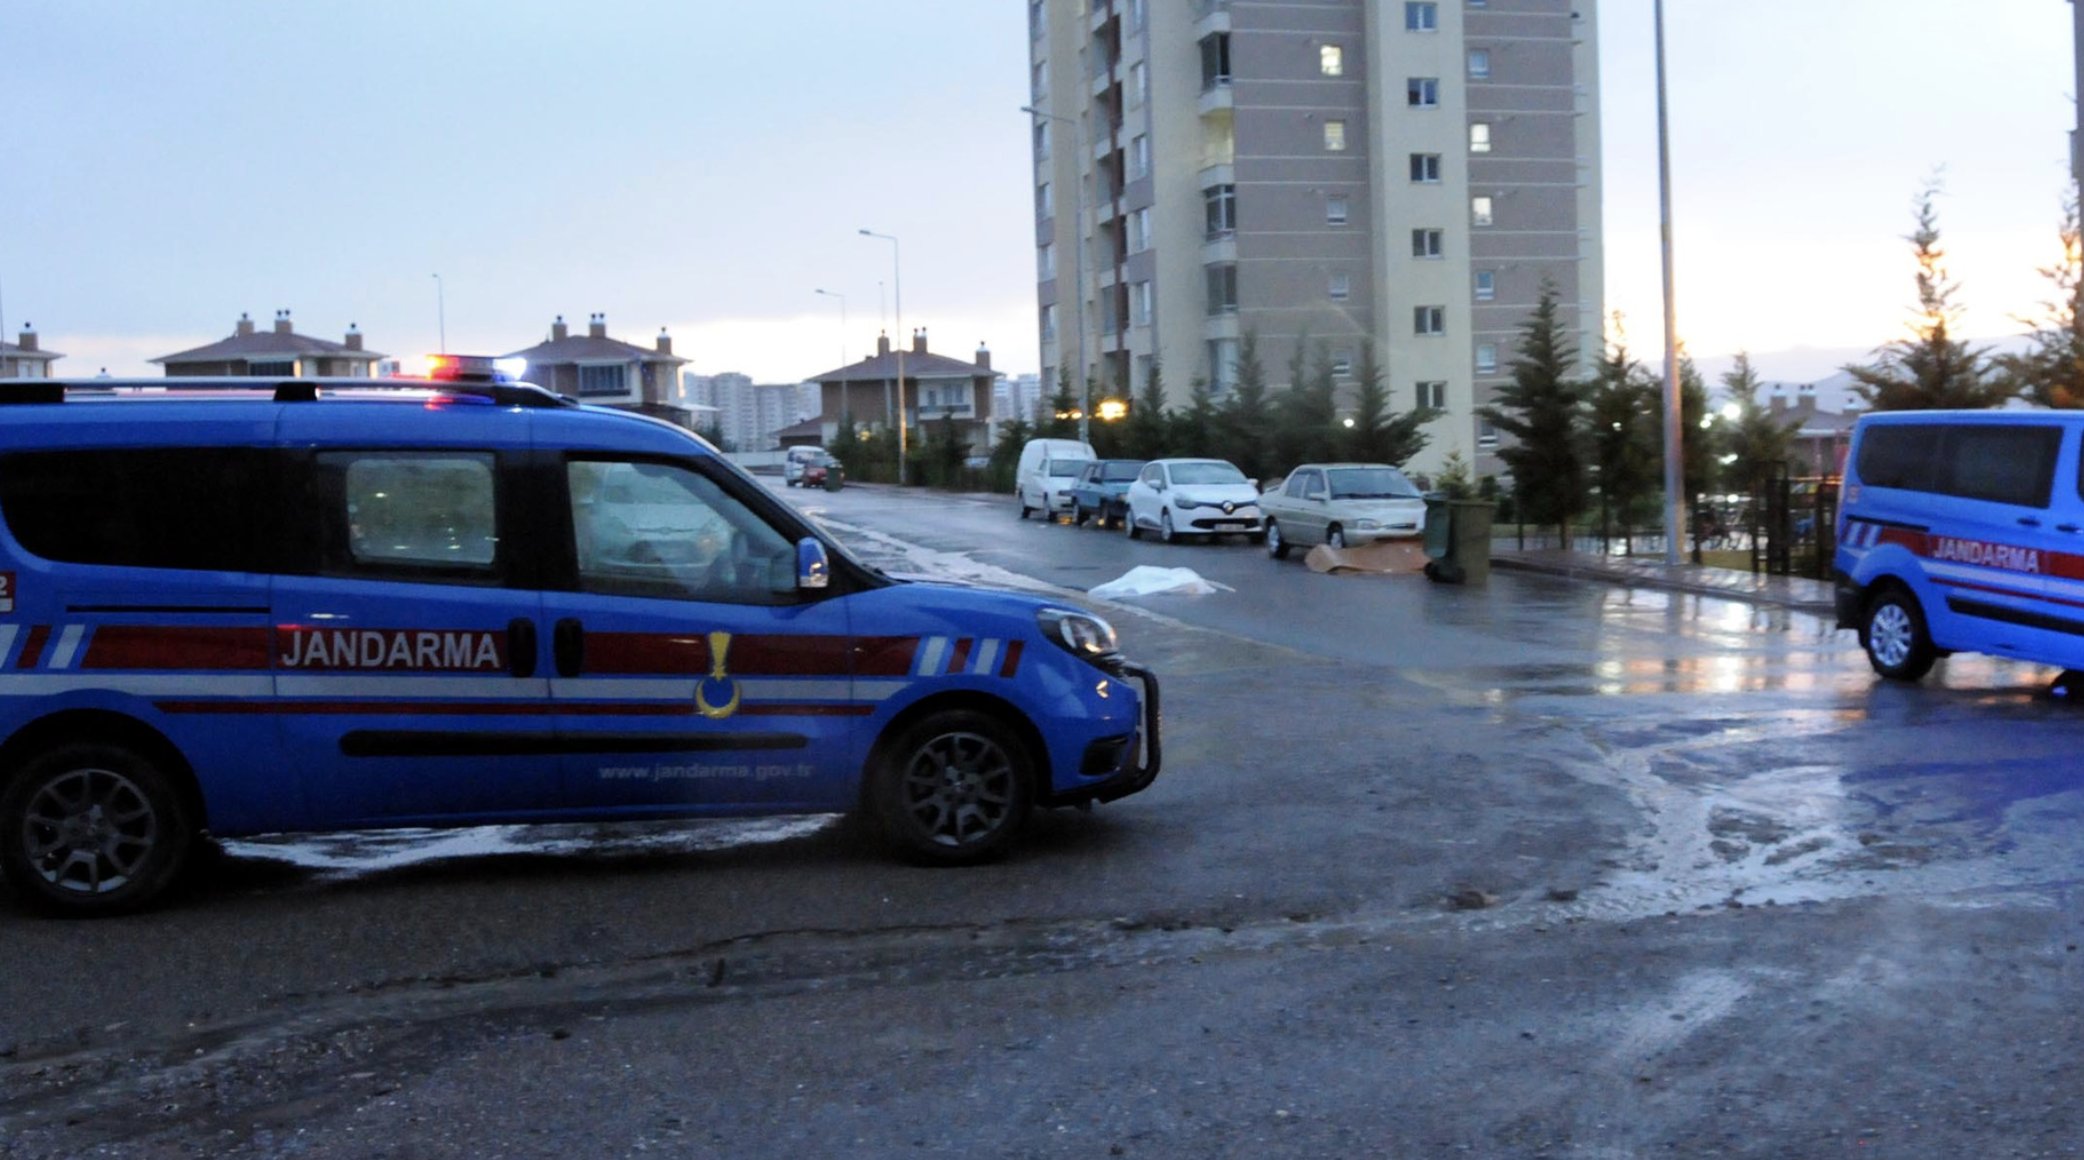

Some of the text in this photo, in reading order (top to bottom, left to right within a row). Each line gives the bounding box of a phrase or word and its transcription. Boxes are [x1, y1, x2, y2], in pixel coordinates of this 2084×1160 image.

[1934, 538, 2039, 572] JANDARMA
[282, 631, 500, 667] JANDARMA
[600, 764, 811, 781] www.jandarma.gov.tr
